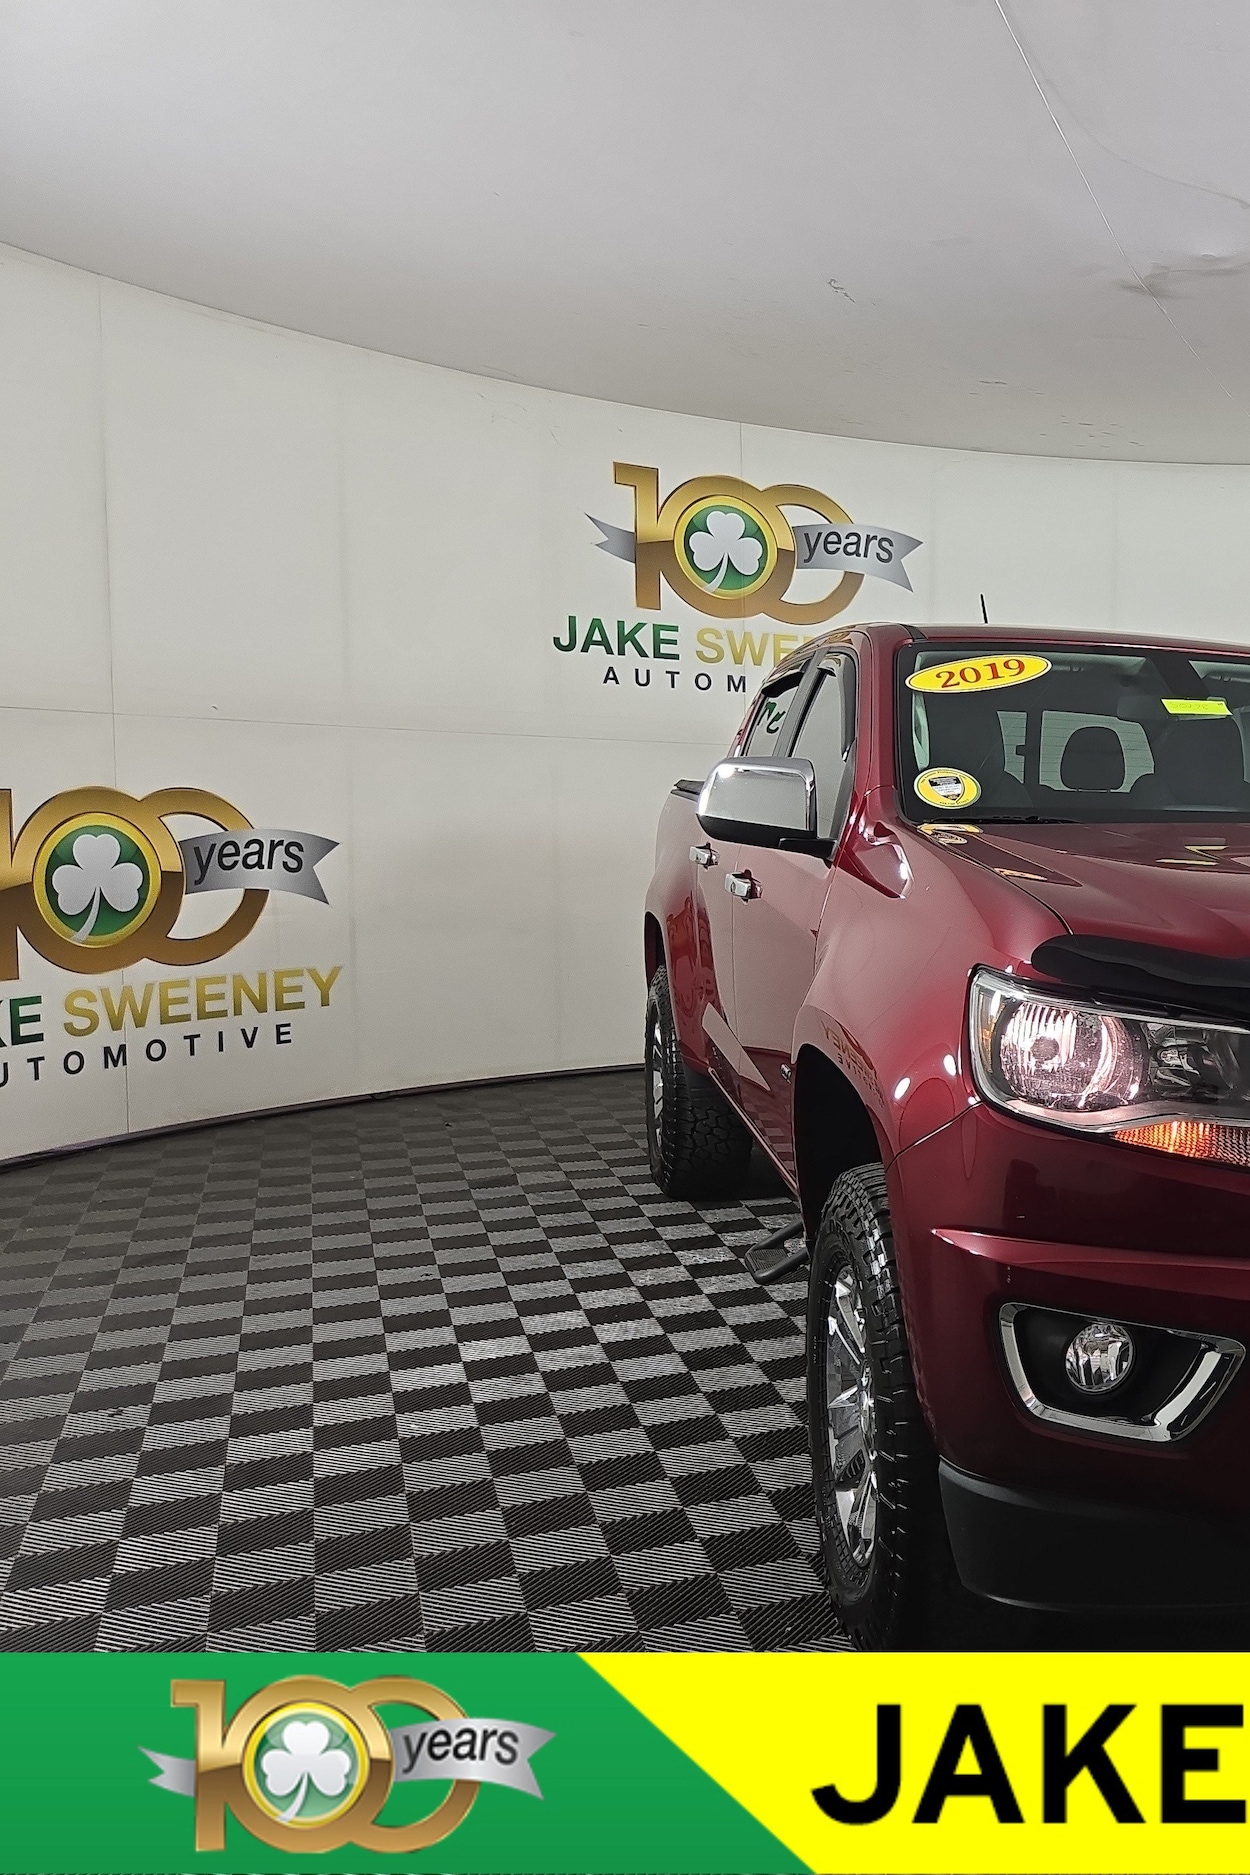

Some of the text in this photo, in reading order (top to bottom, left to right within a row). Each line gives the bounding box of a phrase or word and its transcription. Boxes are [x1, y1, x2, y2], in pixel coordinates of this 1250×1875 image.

[803, 530, 894, 564] years
[552, 615, 681, 661] JAKE
[602, 665, 747, 693] AUTOM
[935, 659, 1026, 689] 2019
[193, 836, 305, 886] years
[63, 965, 343, 1038] SWEENEY
